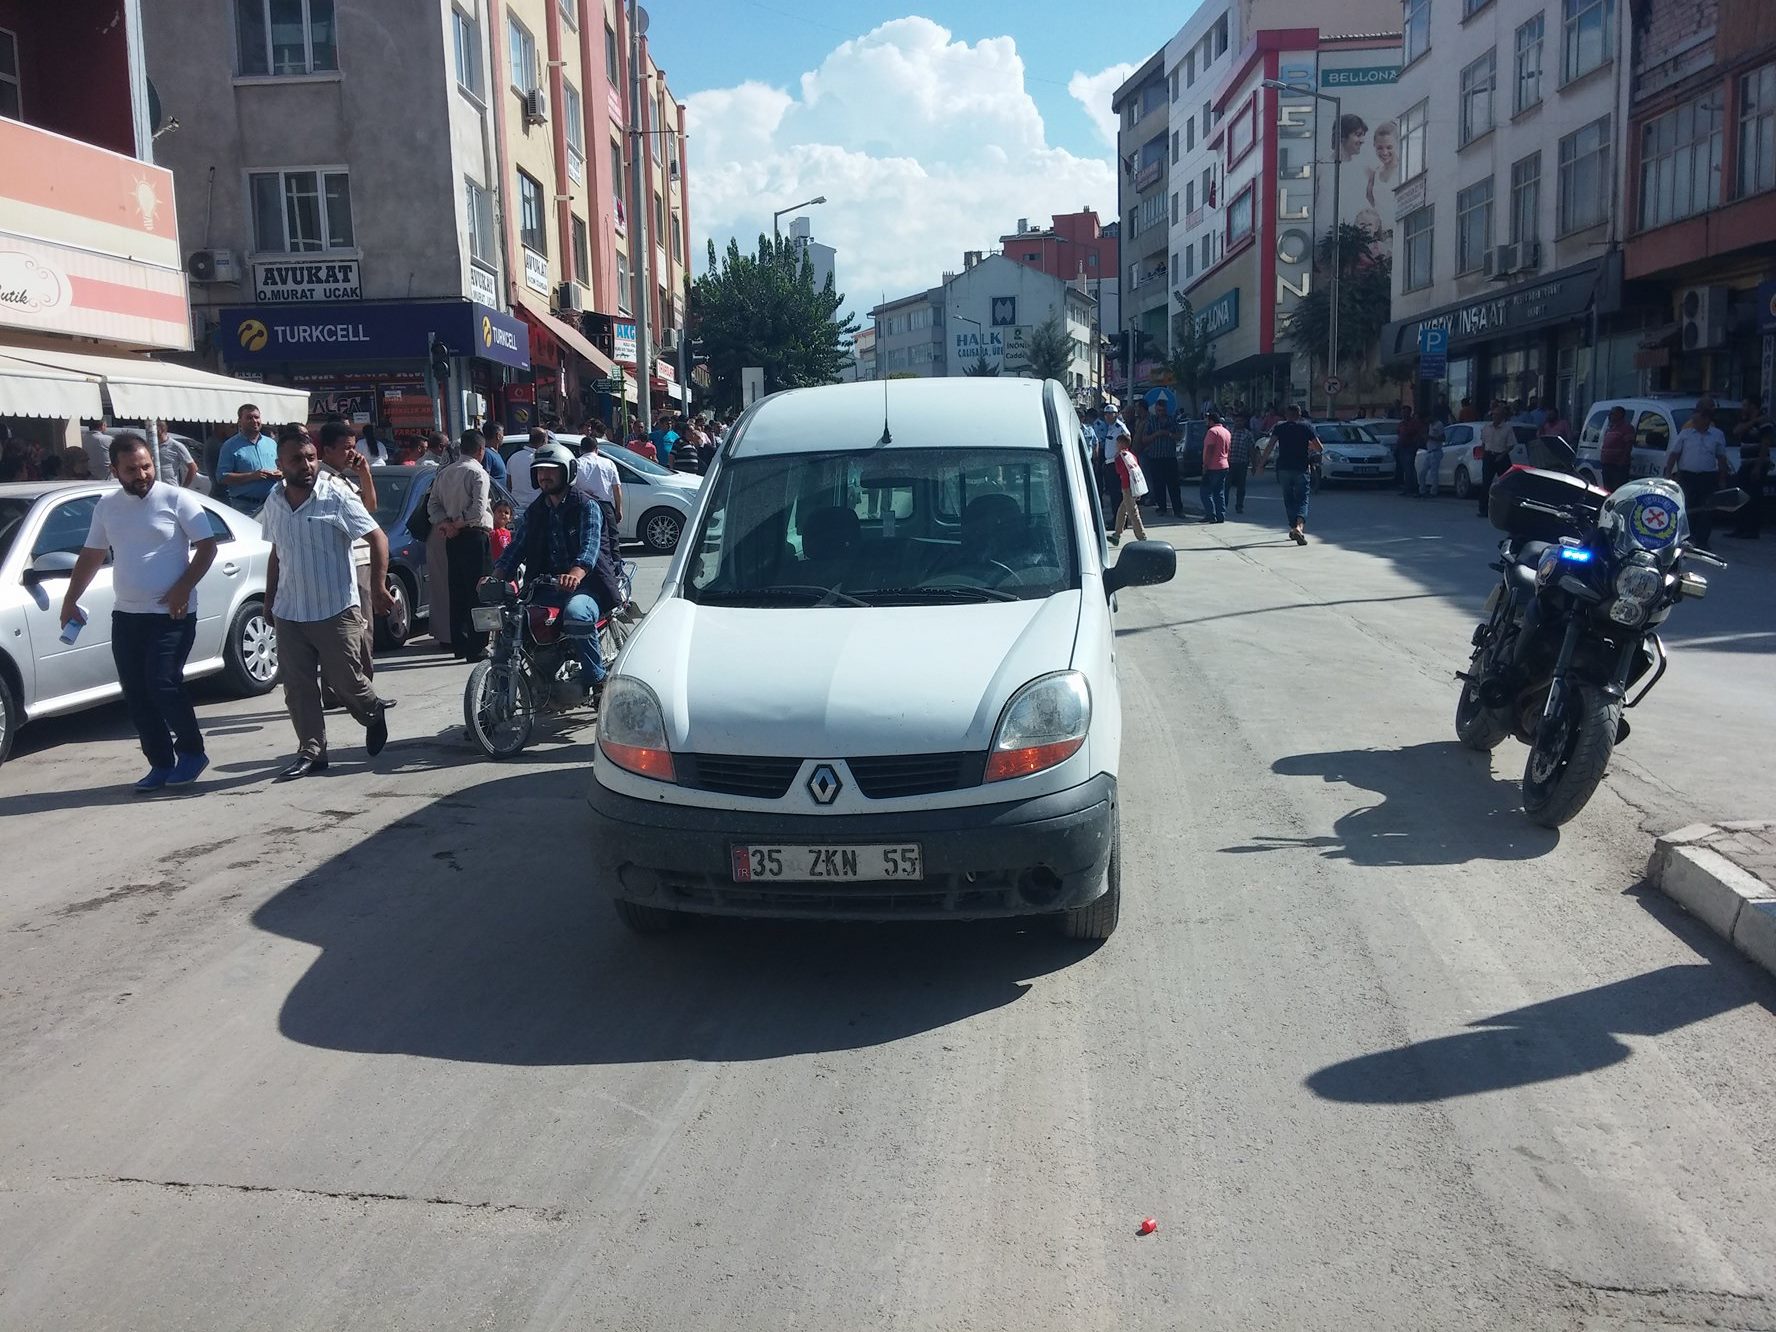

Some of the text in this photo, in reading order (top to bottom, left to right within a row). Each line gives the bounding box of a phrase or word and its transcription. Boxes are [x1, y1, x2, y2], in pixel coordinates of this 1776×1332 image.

[1329, 70, 1398, 83] BELLONA
[262, 264, 352, 286] AVUKAT
[0, 284, 29, 305] utik
[257, 288, 315, 301] O.MURAT
[273, 323, 370, 344] TURKCELL
[492, 326, 518, 351] TURKCELL
[956, 332, 1002, 347] HALK
[1426, 332, 1442, 352] P
[751, 848, 917, 877] 35 ZKN 55
